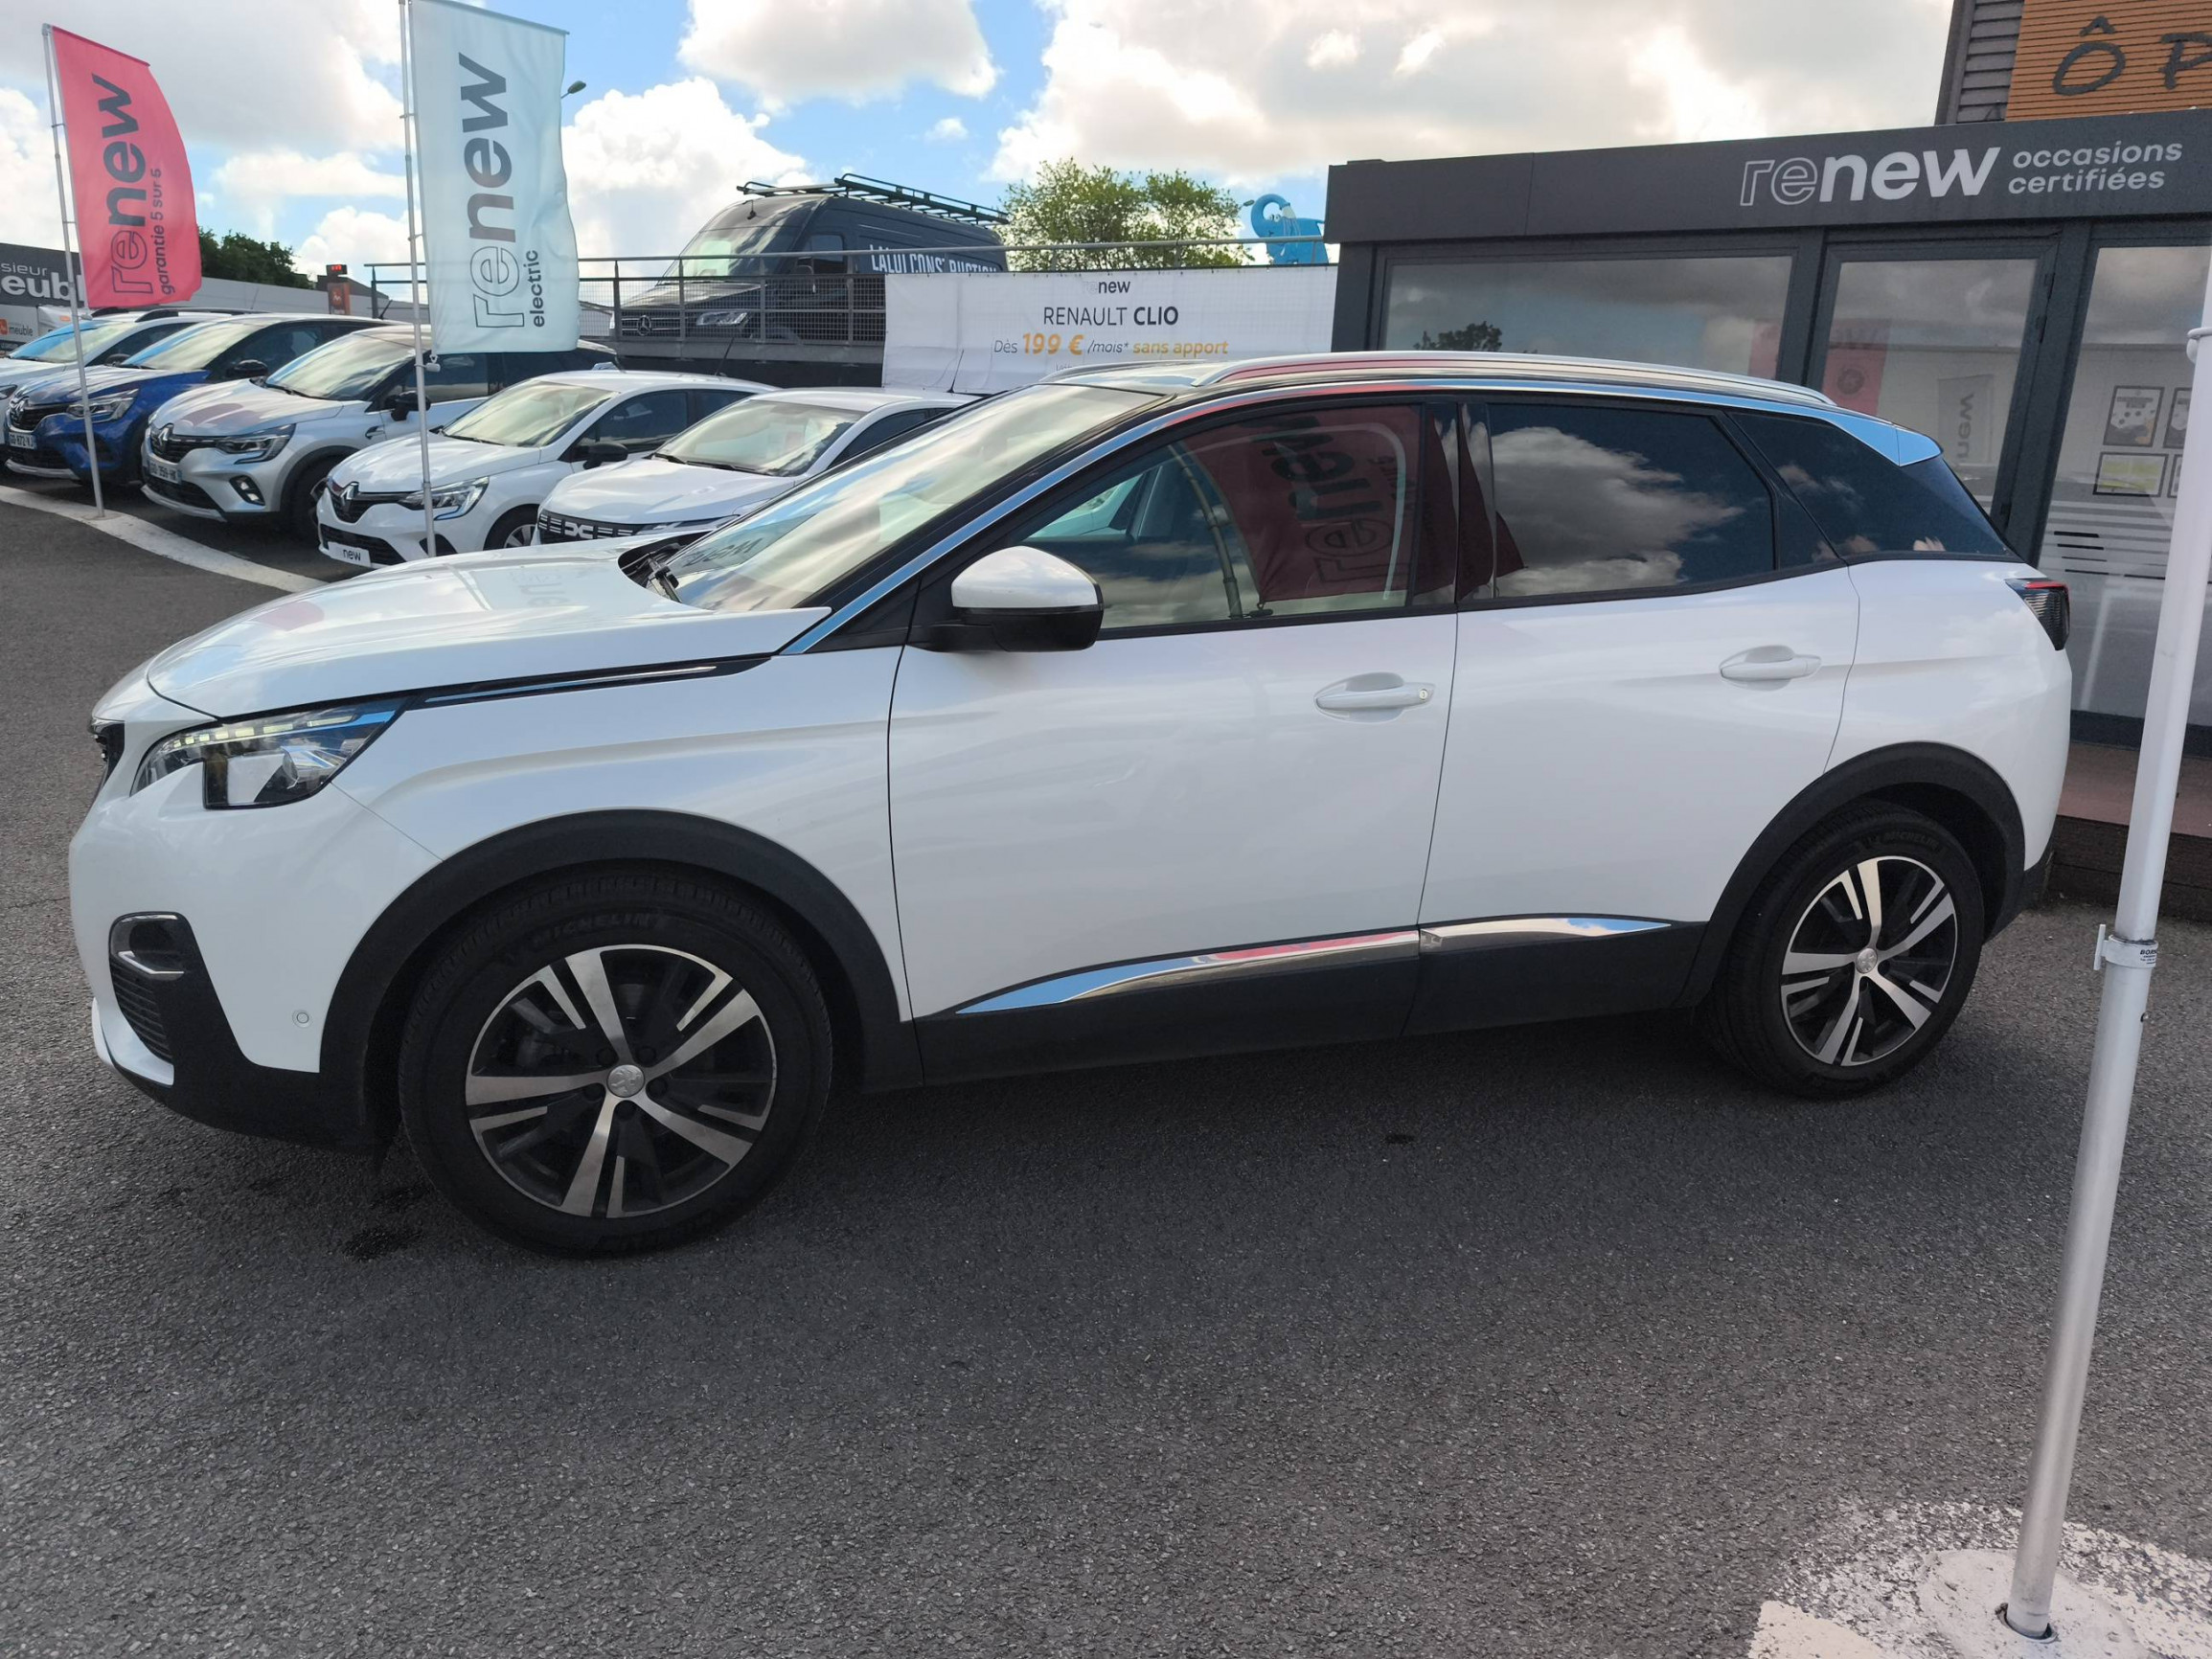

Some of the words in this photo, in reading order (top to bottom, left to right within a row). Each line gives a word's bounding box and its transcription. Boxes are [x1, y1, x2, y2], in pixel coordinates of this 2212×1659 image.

[2053, 15, 2126, 96] Ô
[2013, 140, 2183, 169] occasions
[92, 73, 153, 294] renew
[150, 169, 162, 178] 5
[1740, 147, 2001, 206] renew
[2008, 166, 2165, 194] certifiées
[153, 182, 163, 208] sur
[458, 52, 525, 328] renew
[150, 212, 164, 221] 5
[0, 262, 48, 276] sieur
[150, 225, 175, 295] garantie
[523, 249, 545, 328] electric
[1043, 307, 1128, 327] RENAULT
[1133, 306, 1179, 326] CLIO
[993, 339, 1018, 354] Dès
[1022, 332, 1062, 355] 199
[1067, 333, 1084, 355] €
[1132, 342, 1170, 354] sans
[1173, 340, 1229, 359] apport
[343, 550, 361, 561] new
